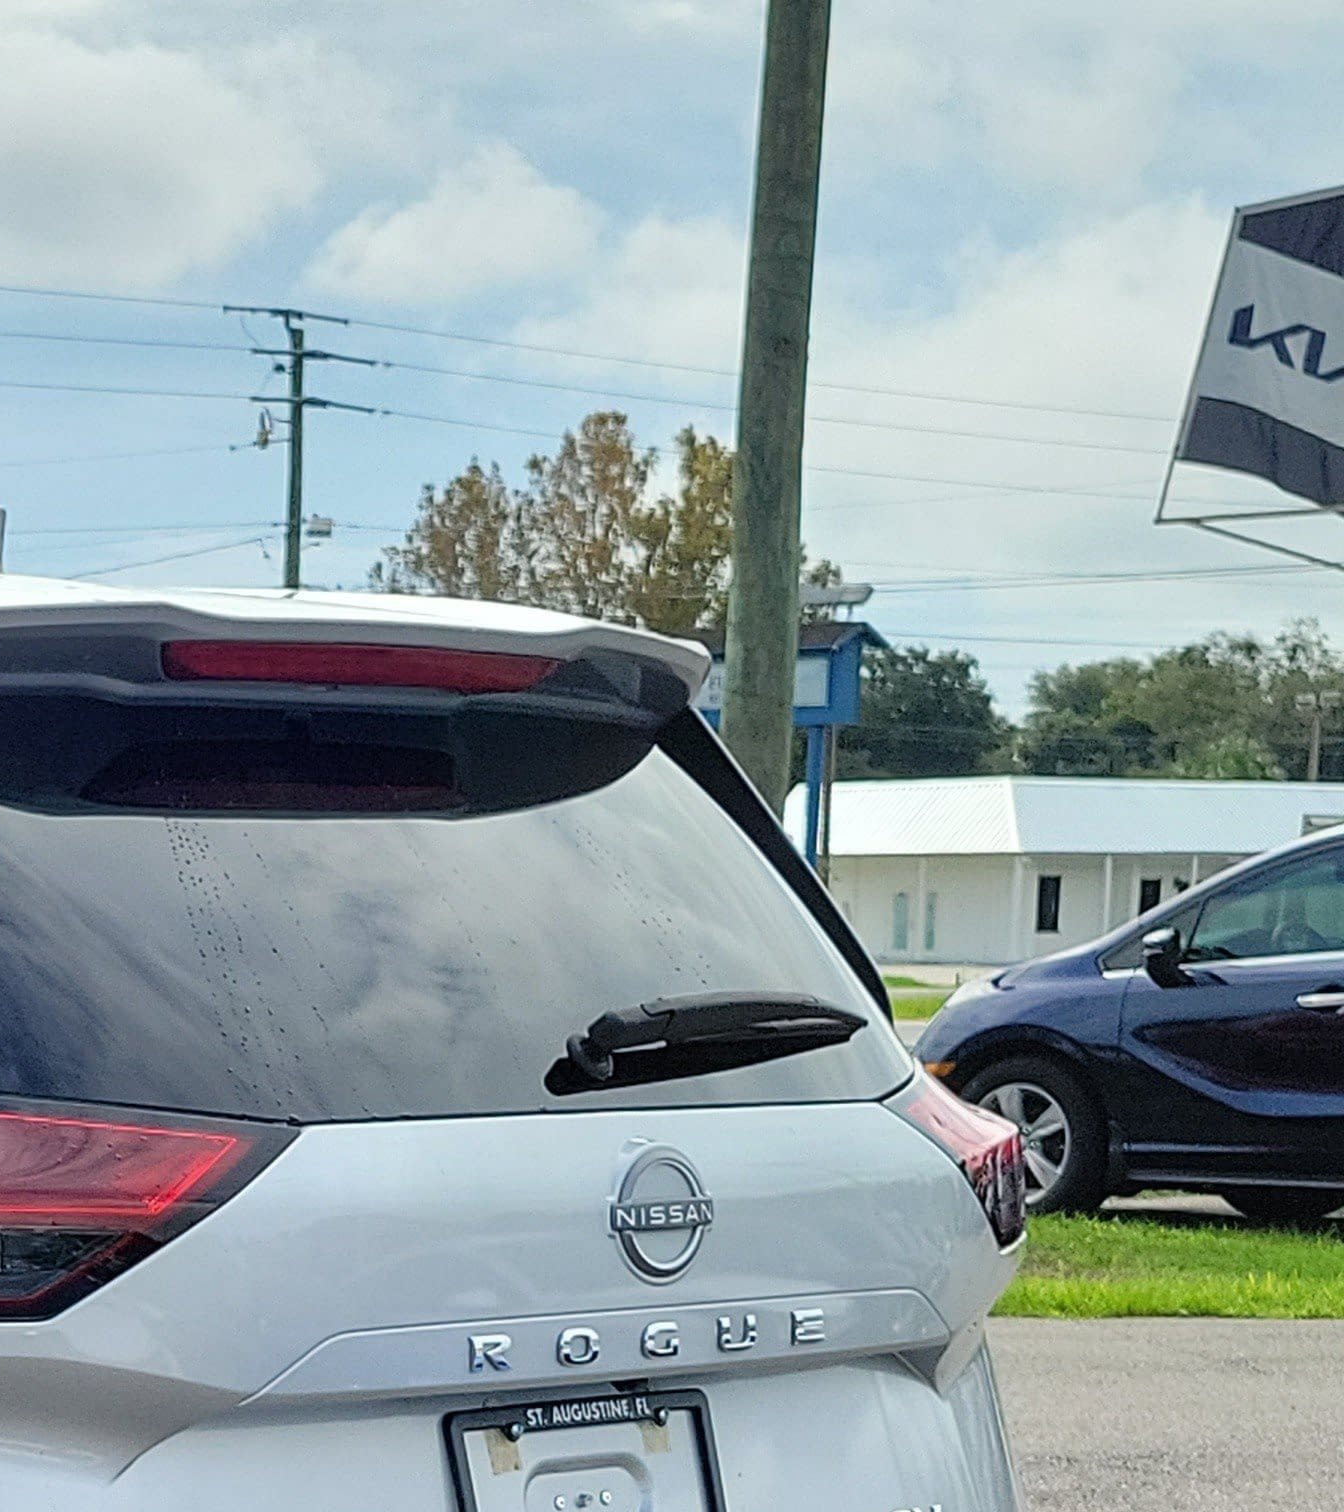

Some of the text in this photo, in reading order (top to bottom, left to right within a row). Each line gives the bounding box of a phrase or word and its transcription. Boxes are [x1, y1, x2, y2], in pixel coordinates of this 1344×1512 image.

[616, 1203, 712, 1228] NISSAN
[468, 1307, 827, 1373] ROGUE
[526, 1407, 548, 1427] ST.
[635, 1397, 651, 1415] FL
